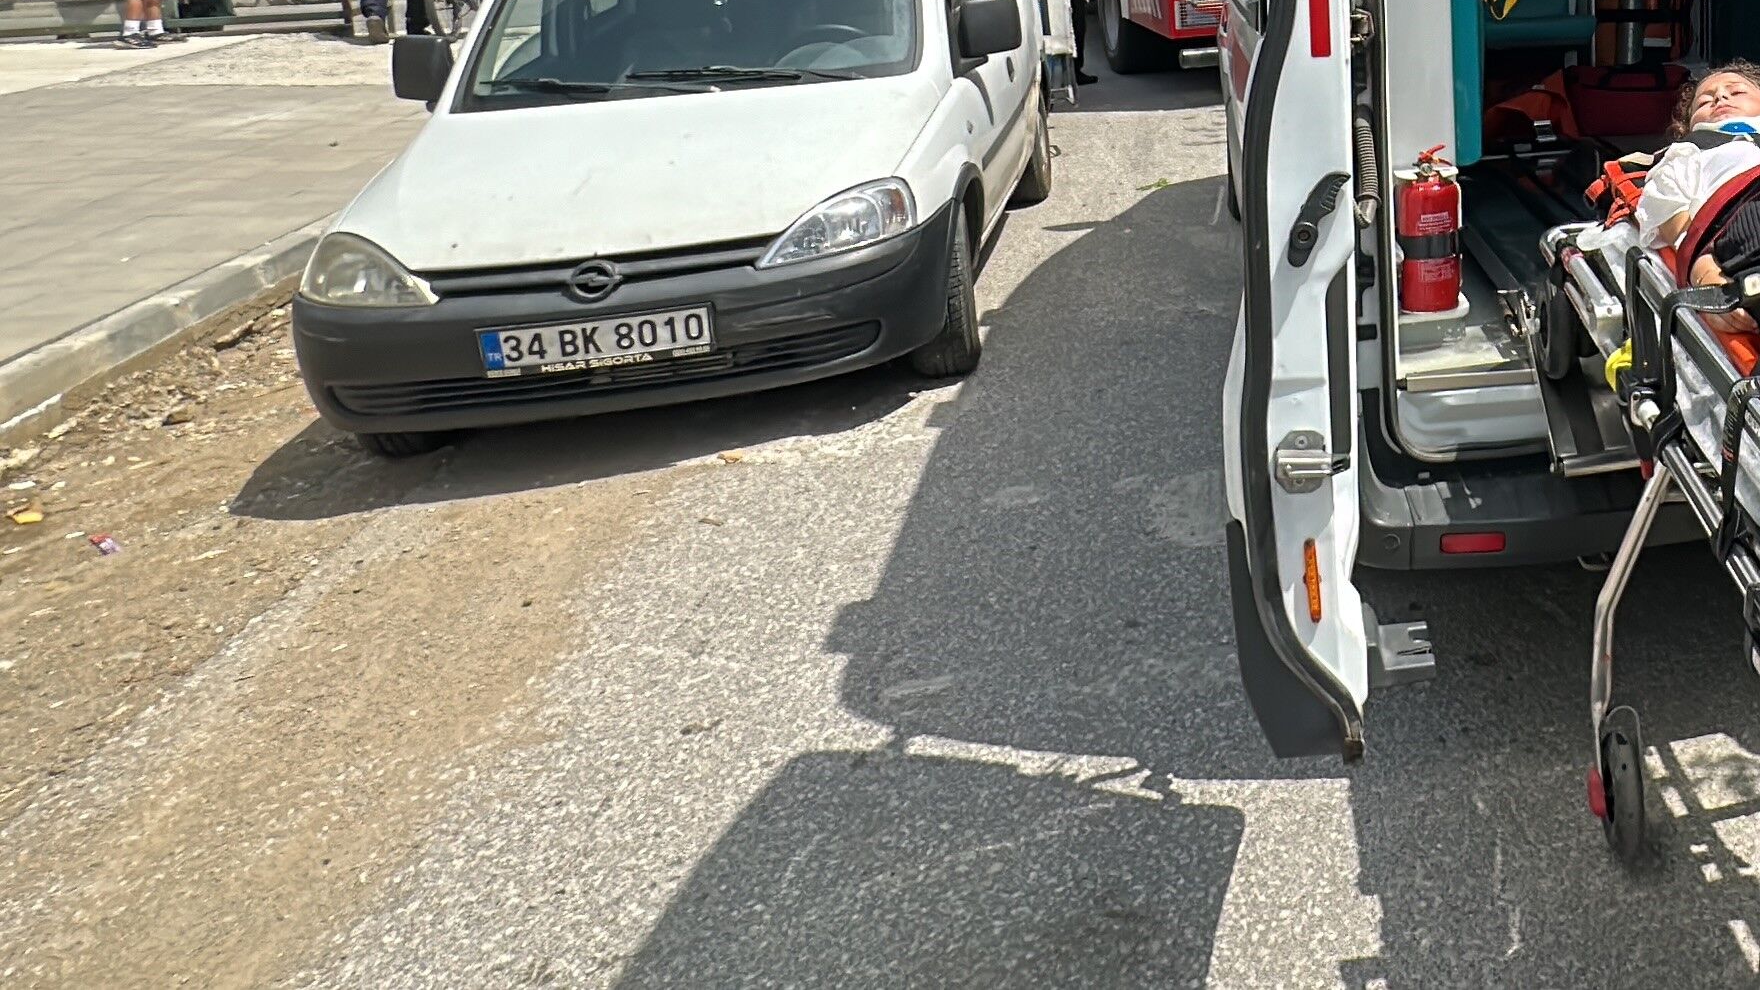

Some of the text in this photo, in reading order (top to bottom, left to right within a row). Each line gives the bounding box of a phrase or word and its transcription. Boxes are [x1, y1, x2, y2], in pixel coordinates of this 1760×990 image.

[503, 313, 704, 362] 34 BK 8010
